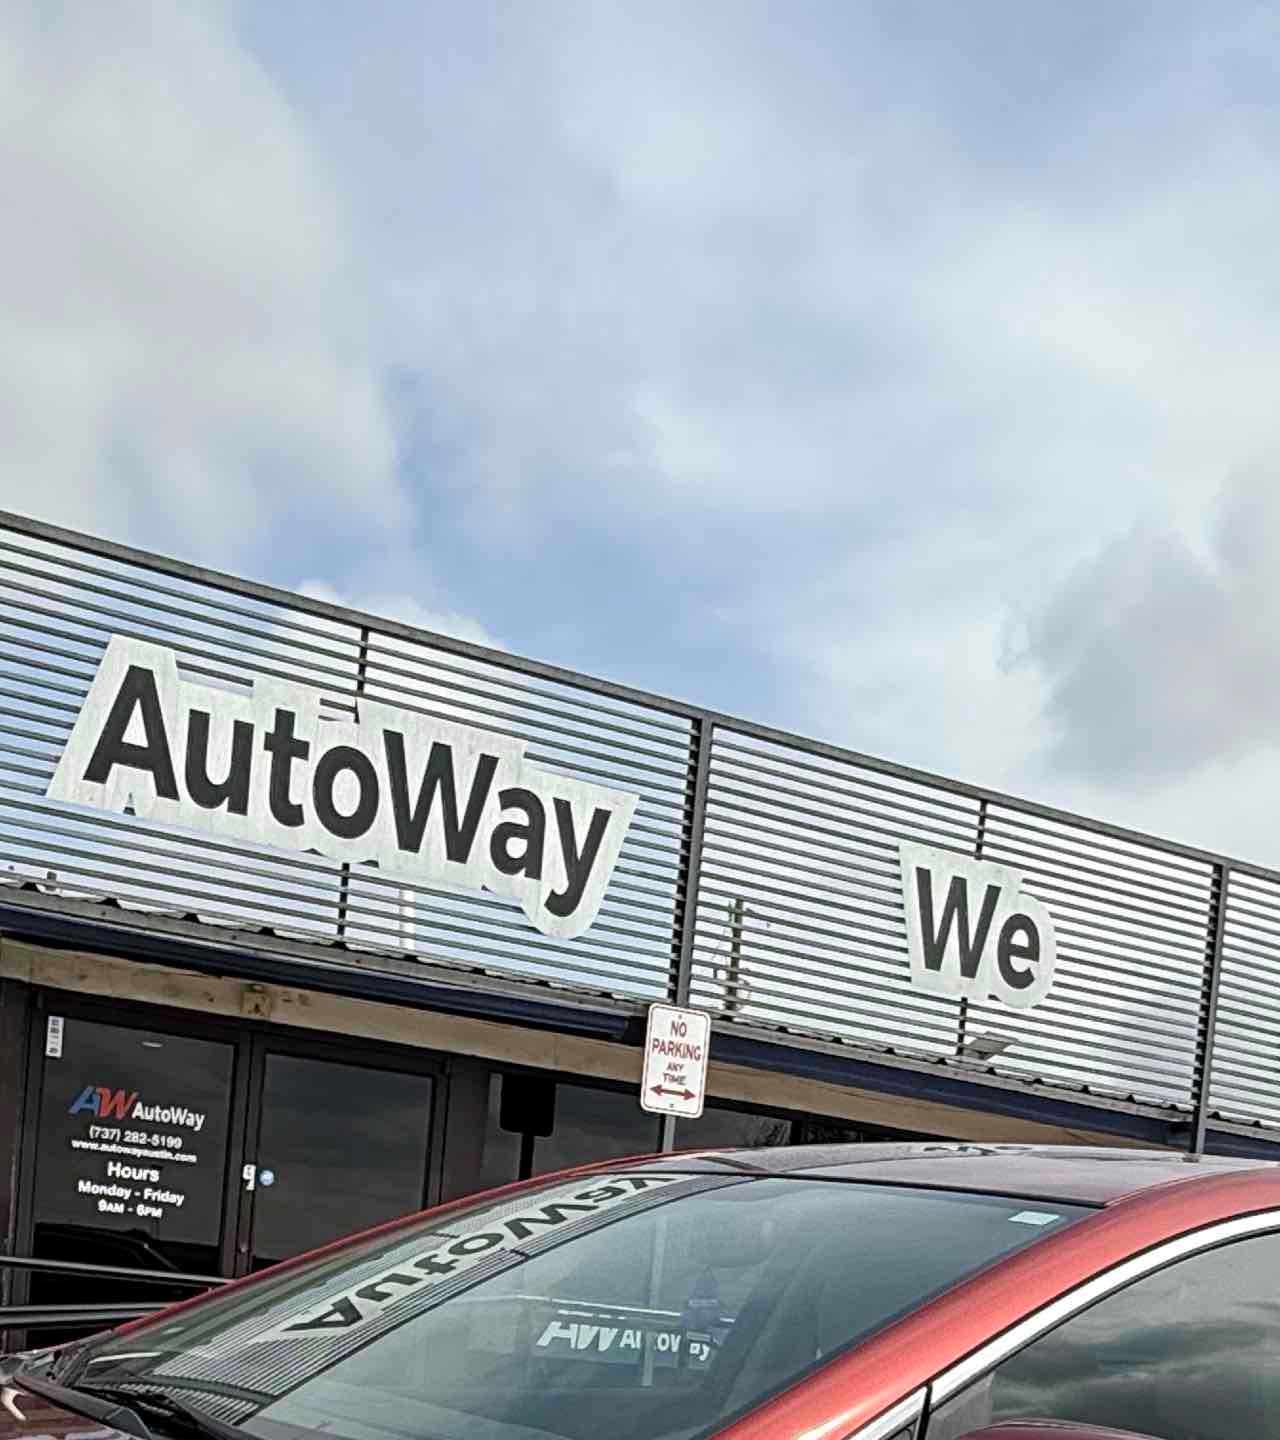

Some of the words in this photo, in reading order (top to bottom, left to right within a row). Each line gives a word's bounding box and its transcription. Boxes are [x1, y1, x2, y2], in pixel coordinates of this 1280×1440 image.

[83, 664, 612, 918] AutoWay
[914, 866, 1041, 991] We
[670, 1020, 687, 1037] NO
[651, 1038, 702, 1061] PARKING
[663, 1072, 687, 1085] TIME
[666, 1062, 684, 1072] ANY
[69, 1085, 139, 1119] AW
[132, 1101, 206, 1132] AutoWay
[89, 1125, 122, 1141] (737)
[124, 1131, 183, 1149] 282-5199
[71, 1138, 198, 1164] www.autowayaustin.com
[107, 1161, 160, 1182] Hours
[78, 1180, 132, 1199] Monday
[143, 1188, 184, 1207] Friday
[98, 1200, 124, 1214] 9AM
[136, 1204, 163, 1219] 6PM
